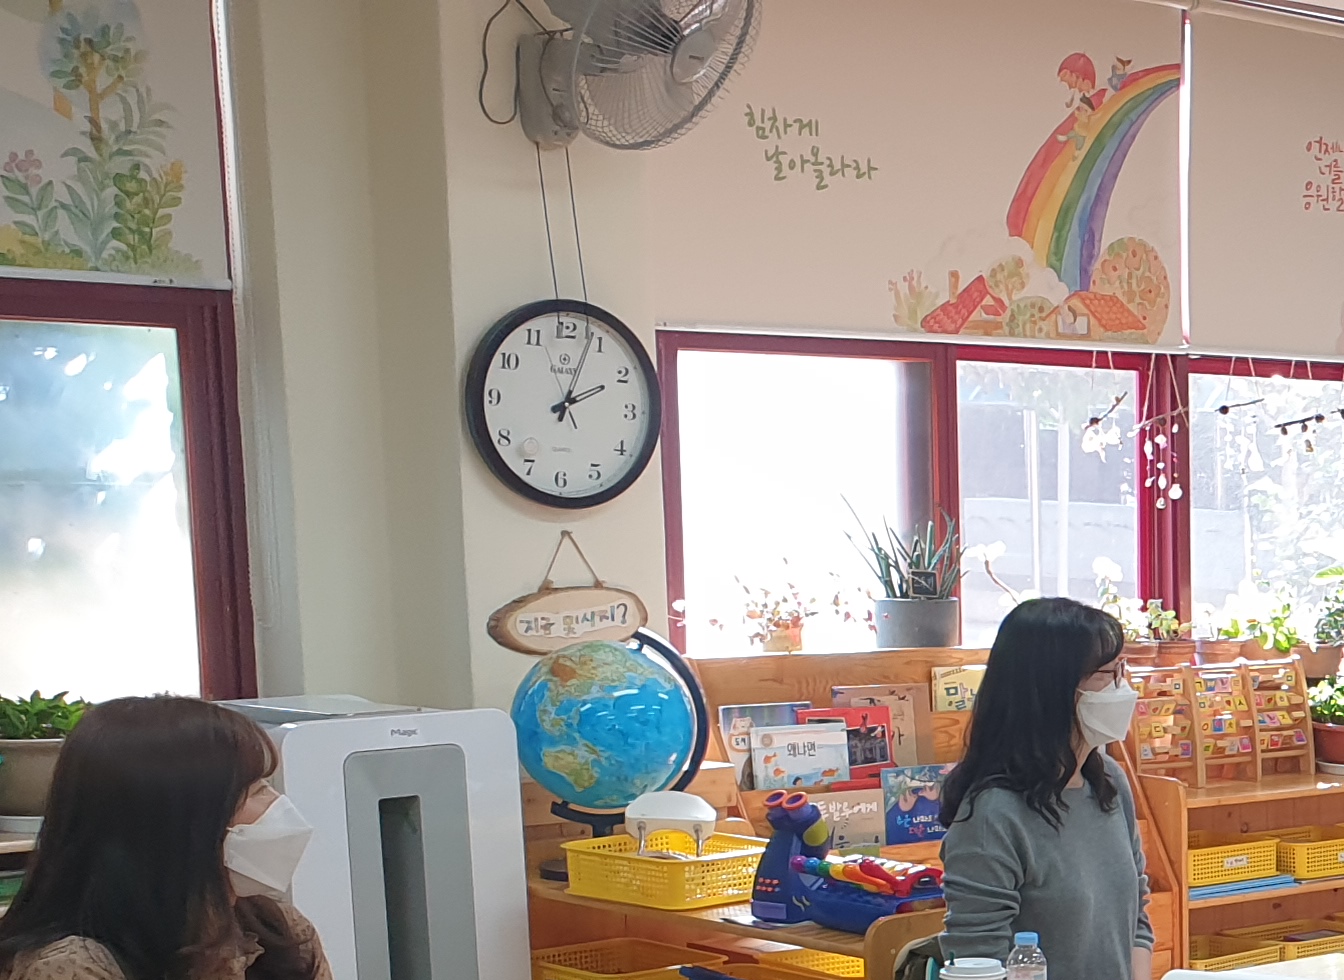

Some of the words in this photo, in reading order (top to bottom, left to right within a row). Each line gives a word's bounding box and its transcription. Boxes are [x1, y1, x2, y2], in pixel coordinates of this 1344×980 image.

[743, 102, 820, 141] 힘차게
[763, 144, 879, 192] 날아올라라
[1318, 158, 1344, 185] 너를
[524, 327, 543, 347] 11
[595, 336, 605, 354] 1
[499, 351, 521, 371] 10
[616, 366, 631, 385] 2
[487, 388, 502, 407] 9
[623, 402, 638, 421] 3
[496, 428, 512, 447] 8
[613, 439, 628, 456] 4
[522, 458, 537, 477] 7
[587, 462, 602, 481] 5
[553, 470, 569, 489] 6
[519, 616, 556, 636] 지금
[943, 682, 977, 711] 말
